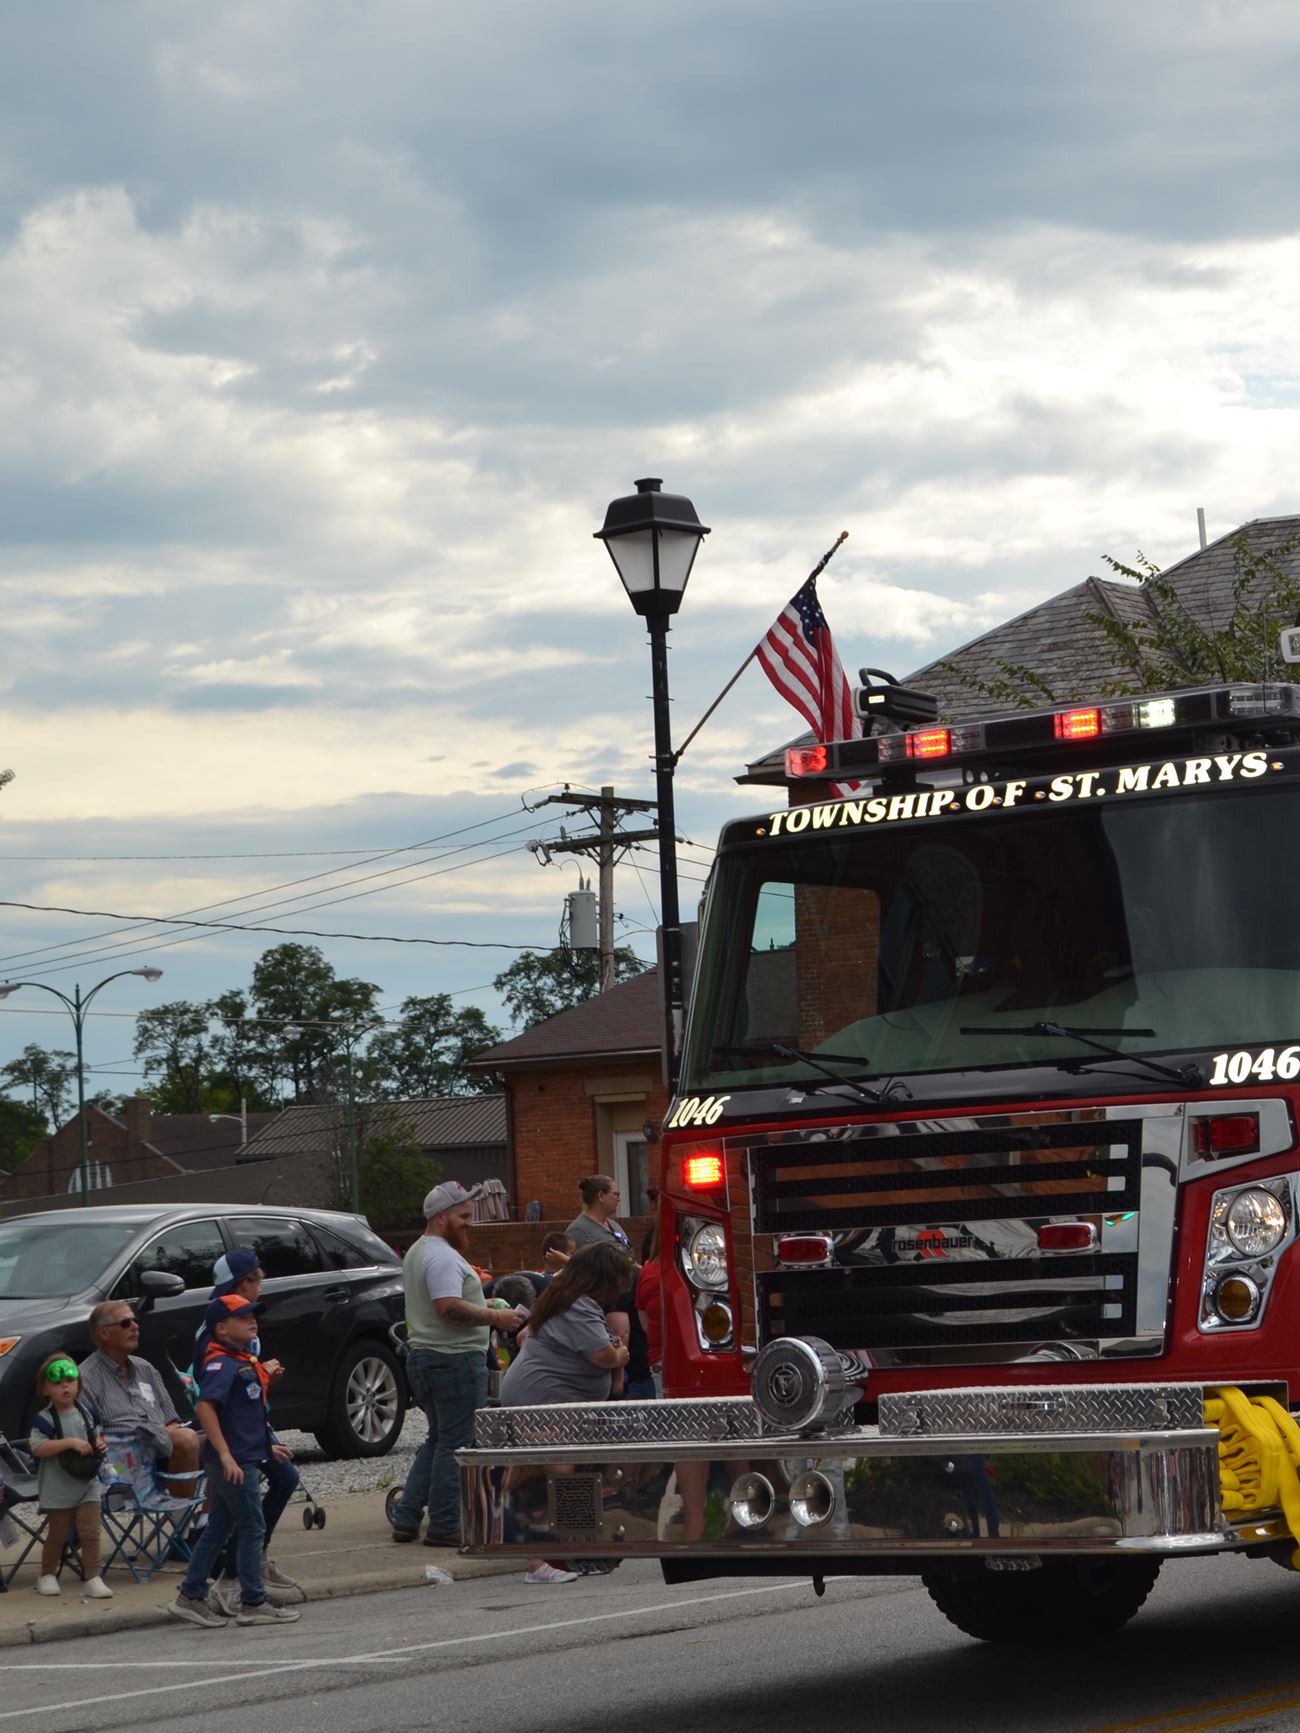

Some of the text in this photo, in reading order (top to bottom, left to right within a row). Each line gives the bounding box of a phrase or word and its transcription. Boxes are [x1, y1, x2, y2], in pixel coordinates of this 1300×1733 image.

[769, 752, 1268, 837] TOWNSHIP OF ST. MARYS
[667, 1095, 731, 1129] 1046
[891, 1233, 974, 1251] rosenbauer
